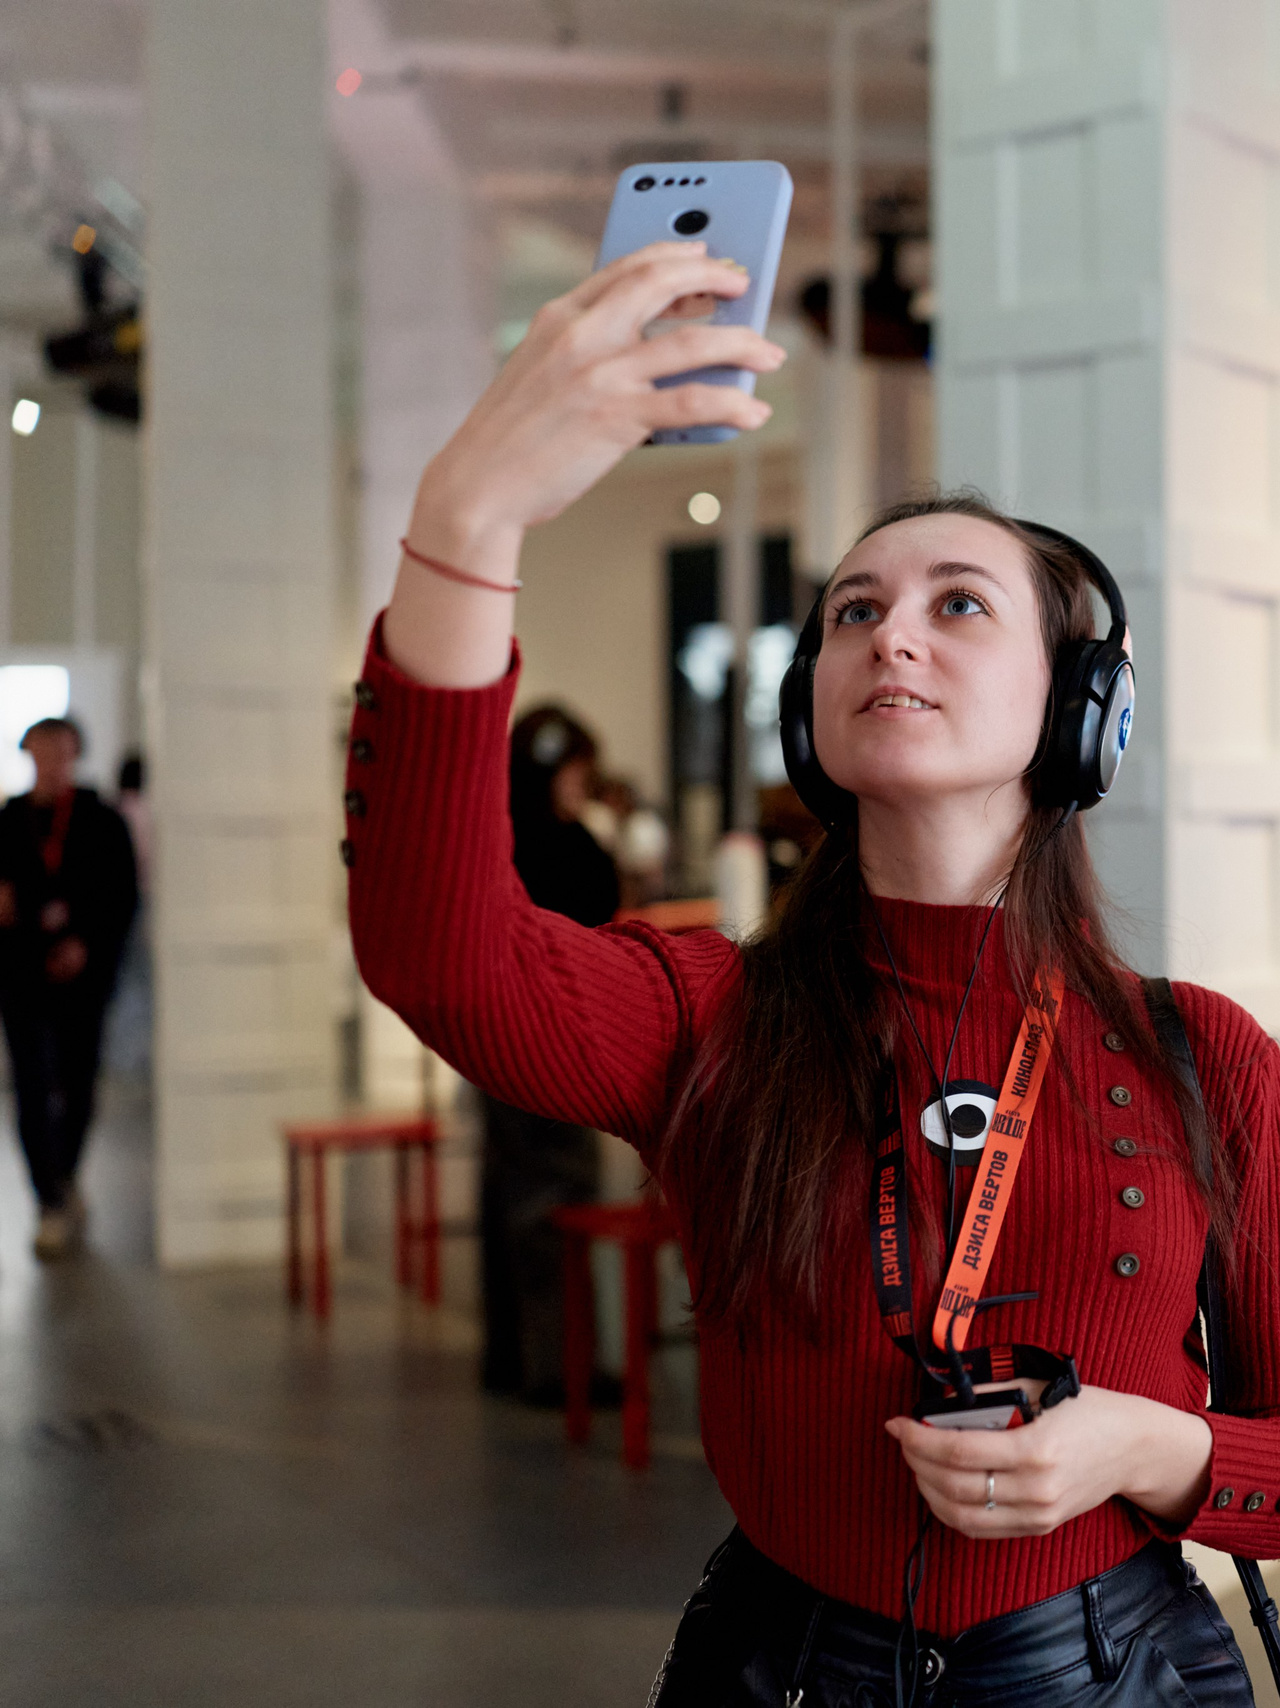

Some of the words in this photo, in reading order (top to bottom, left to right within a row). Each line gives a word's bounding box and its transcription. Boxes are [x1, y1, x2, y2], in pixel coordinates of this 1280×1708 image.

[1011, 1024, 1044, 1098] КИНОГЛАЗ
[879, 1166, 896, 1226] ВЕРТОВ
[962, 1212, 991, 1270] ДЗИГА
[979, 1150, 1009, 1212] ВЕРТОВ
[880, 1228, 902, 1287] ДЗИГА
